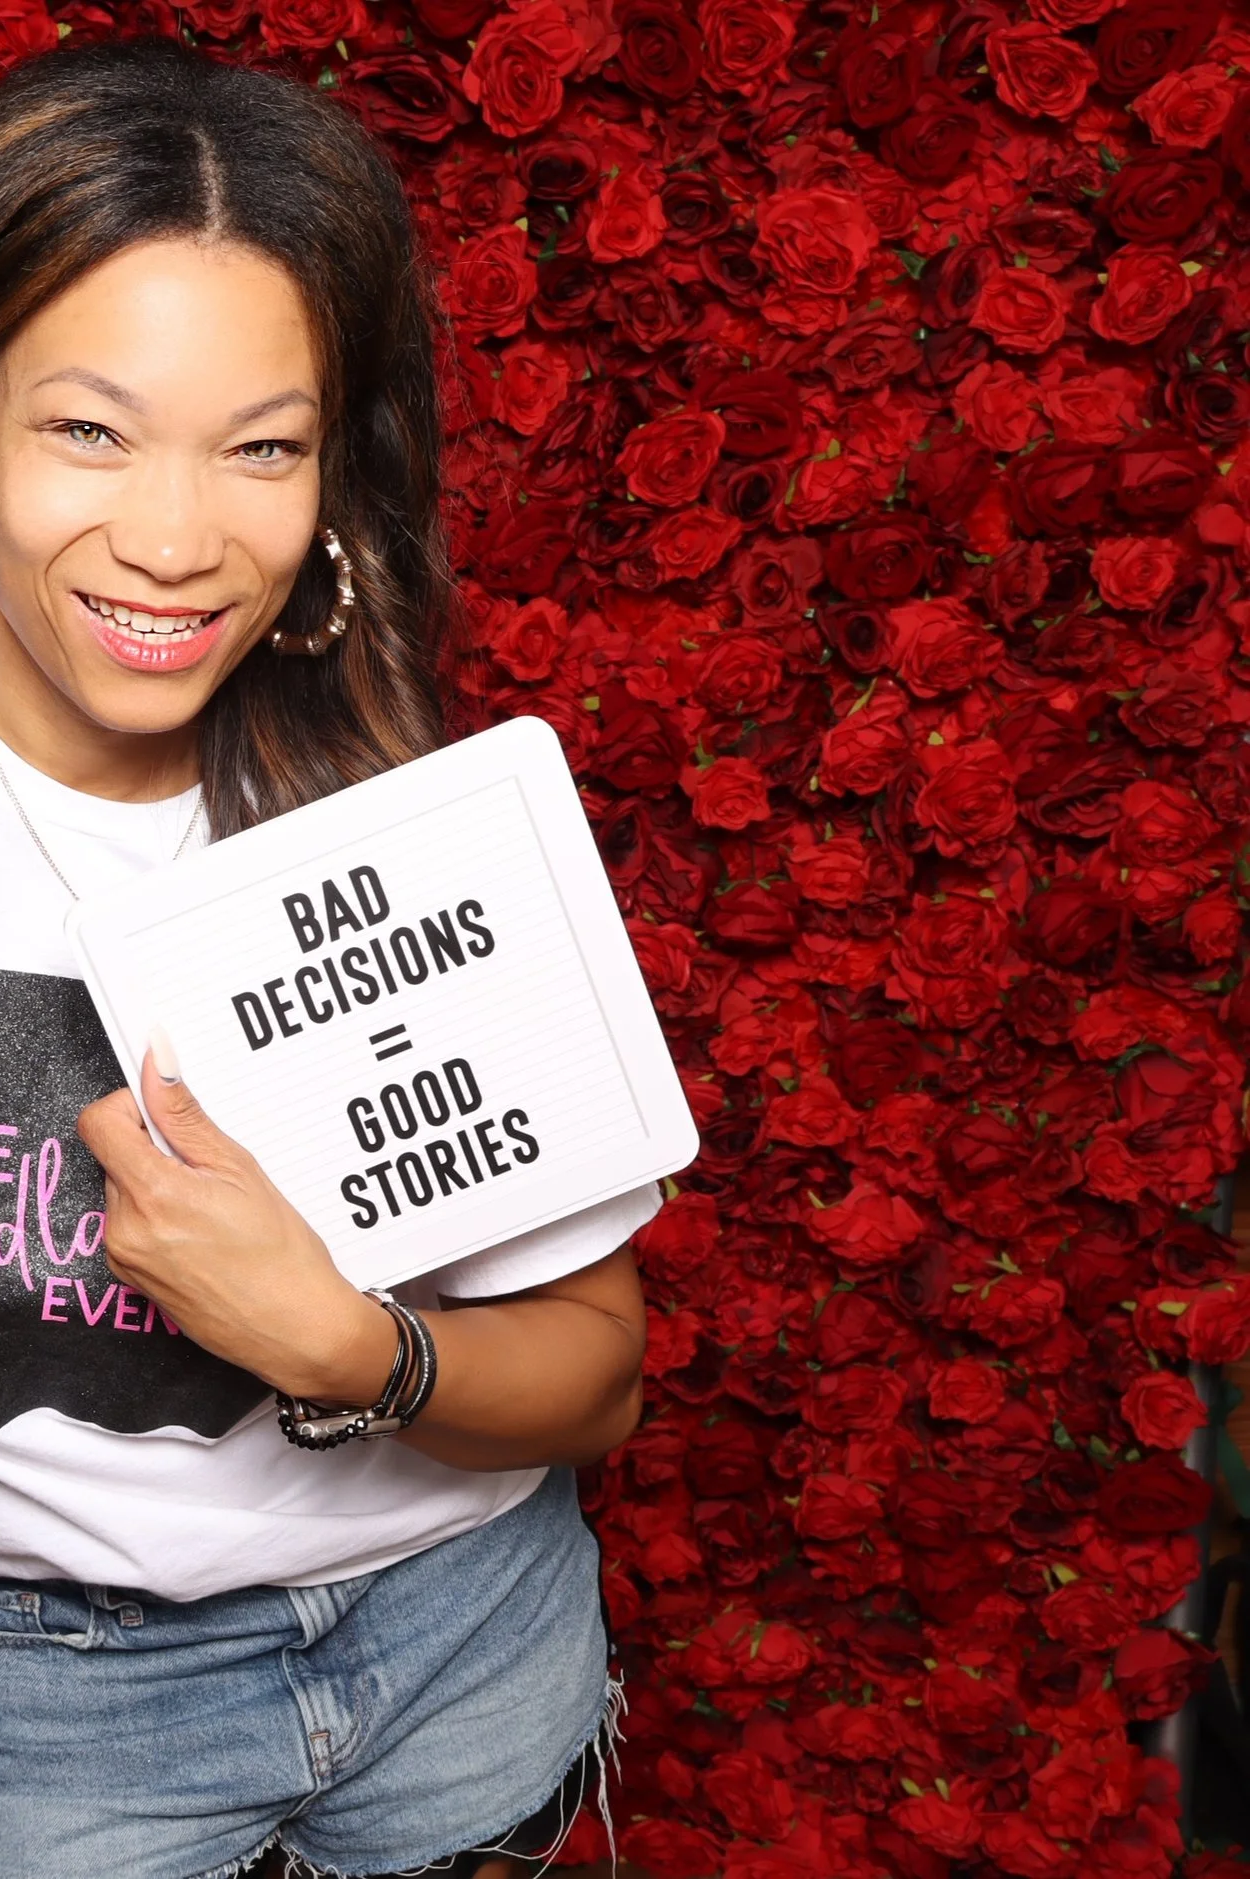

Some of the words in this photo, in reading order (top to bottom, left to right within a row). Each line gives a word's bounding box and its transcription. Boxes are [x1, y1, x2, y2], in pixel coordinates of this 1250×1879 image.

[282, 865, 390, 954] BAD
[231, 899, 495, 1051] DECISIONS
[369, 1023, 413, 1061] =
[346, 1057, 483, 1153] GOOD
[340, 1108, 540, 1229] STORIES
